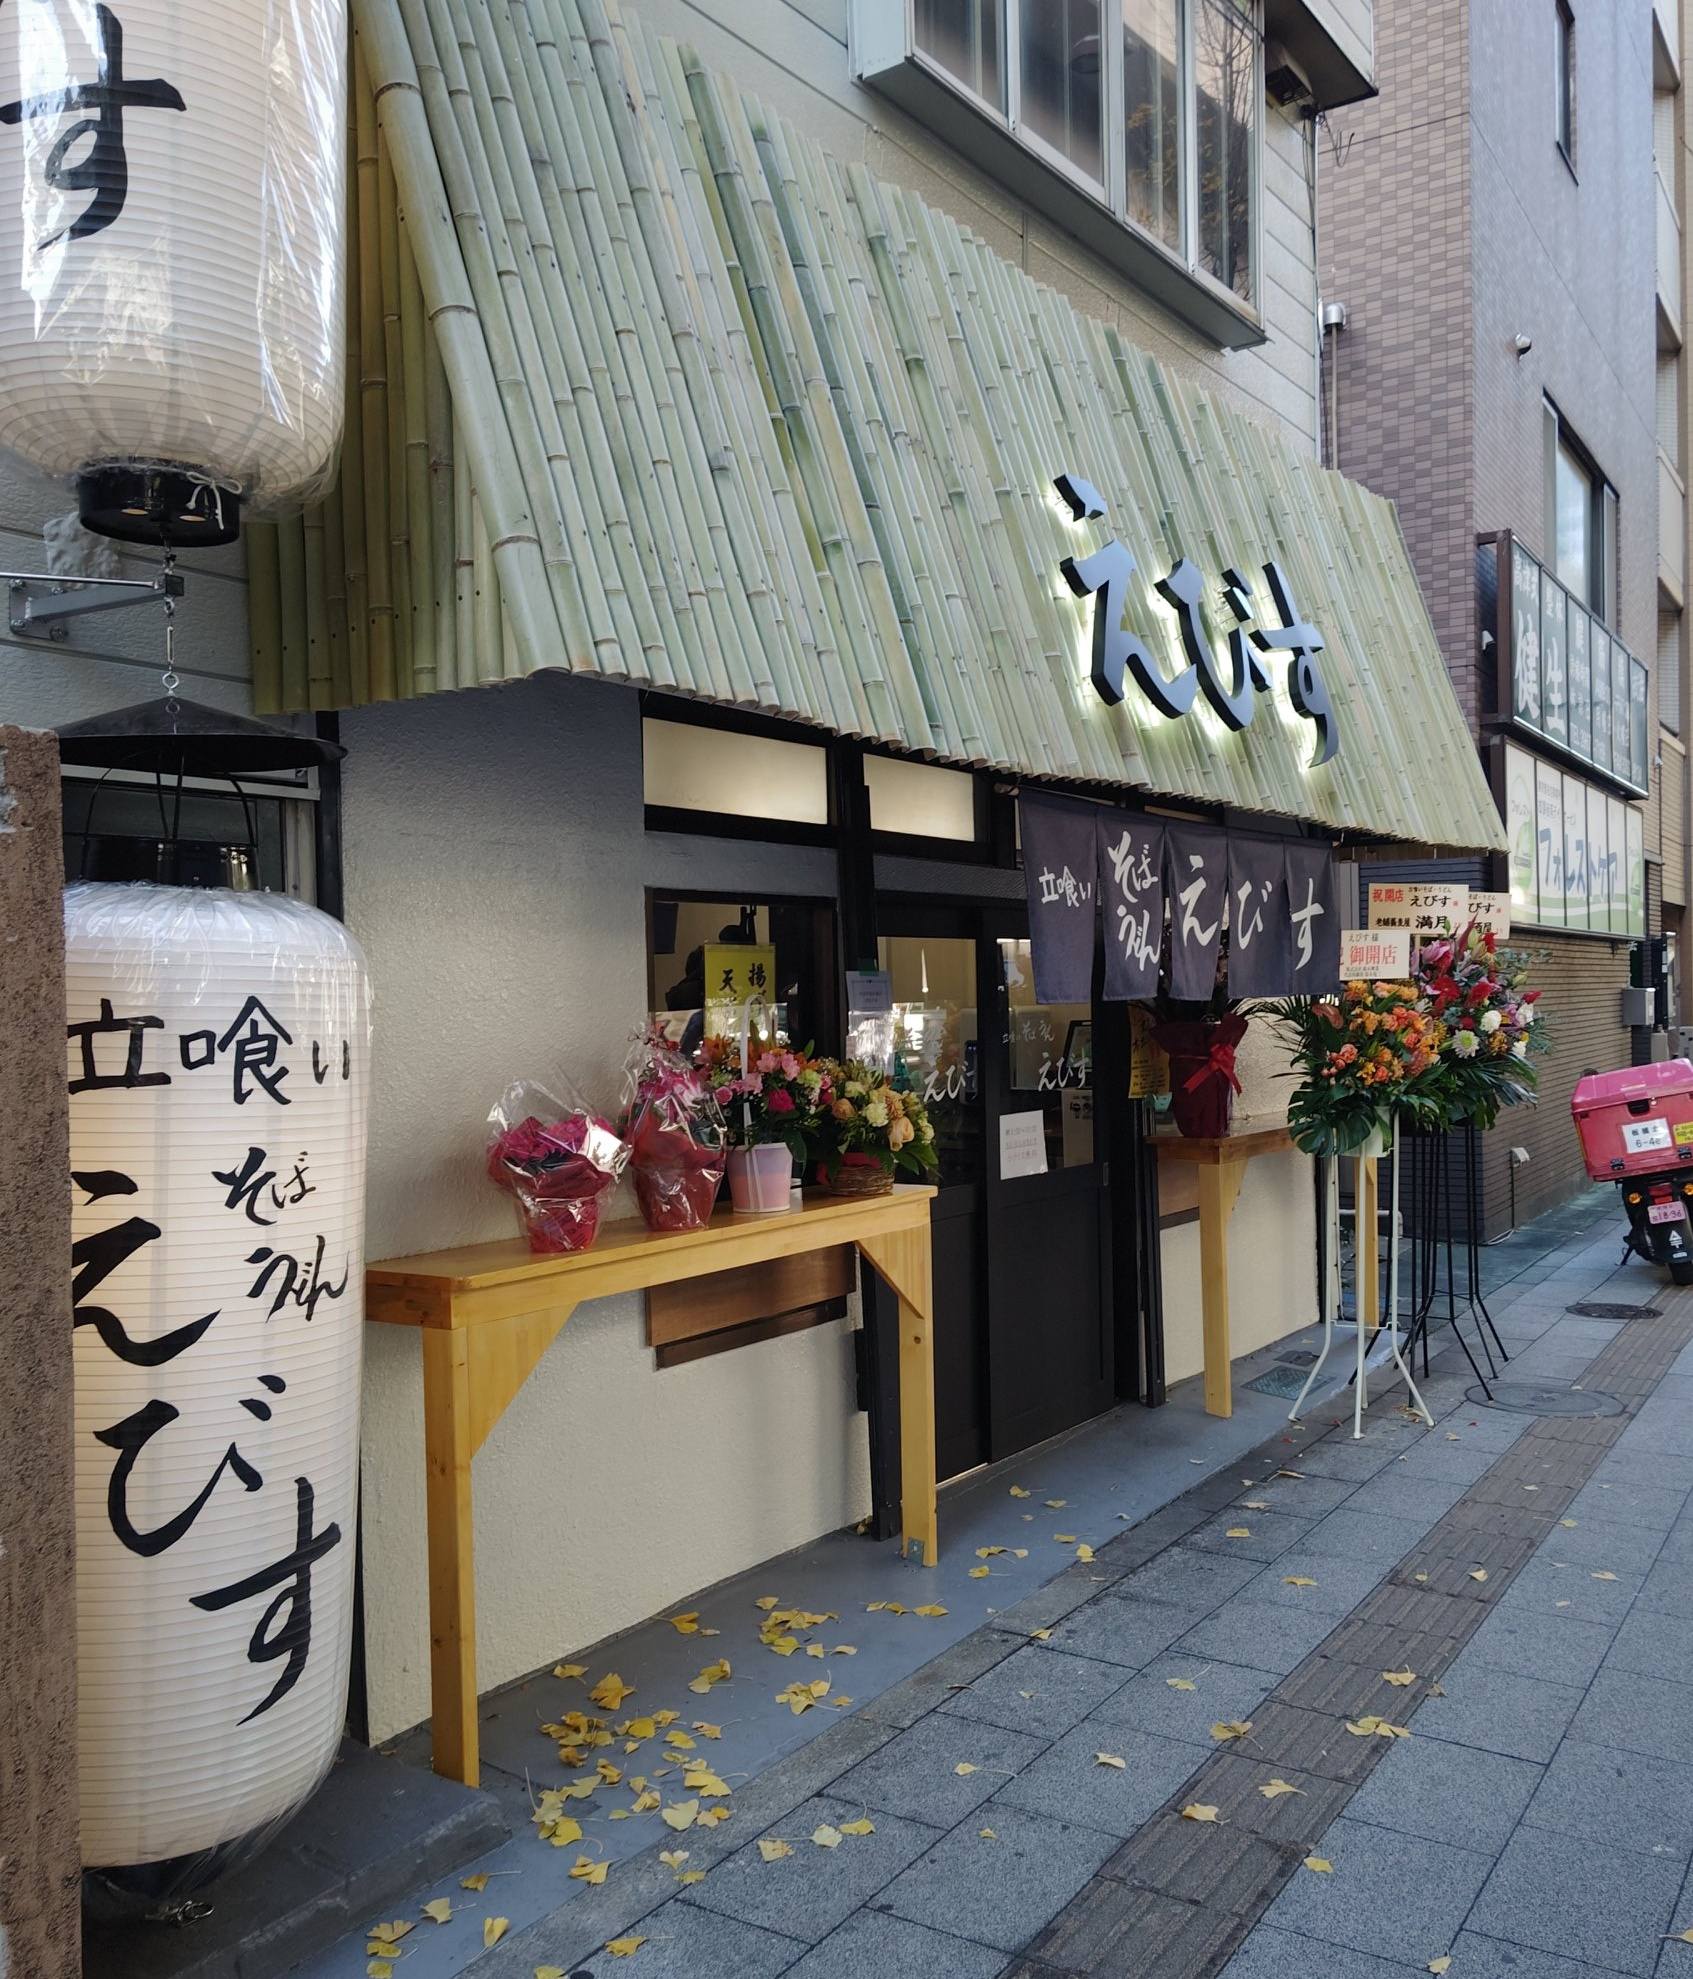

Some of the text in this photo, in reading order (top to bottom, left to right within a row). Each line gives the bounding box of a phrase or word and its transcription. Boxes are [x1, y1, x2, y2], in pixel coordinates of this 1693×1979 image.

[0, 0, 187, 252] す
[1053, 473, 1340, 769] えびす
[1039, 866, 1092, 907] 立喰い
[1107, 830, 1159, 903] そば
[1410, 895, 1451, 907] えびす
[1539, 828, 1618, 903] フォレストケア
[1116, 905, 1161, 971] うどん
[1179, 854, 1325, 971] えびす
[1415, 915, 1449, 929] 満月
[1350, 945, 1397, 965] 御開店
[69, 996, 351, 1106] 立喰い
[1038, 1051, 1090, 1091] えびす
[213, 1150, 317, 1226] そば
[72, 1170, 342, 1727] えびす
